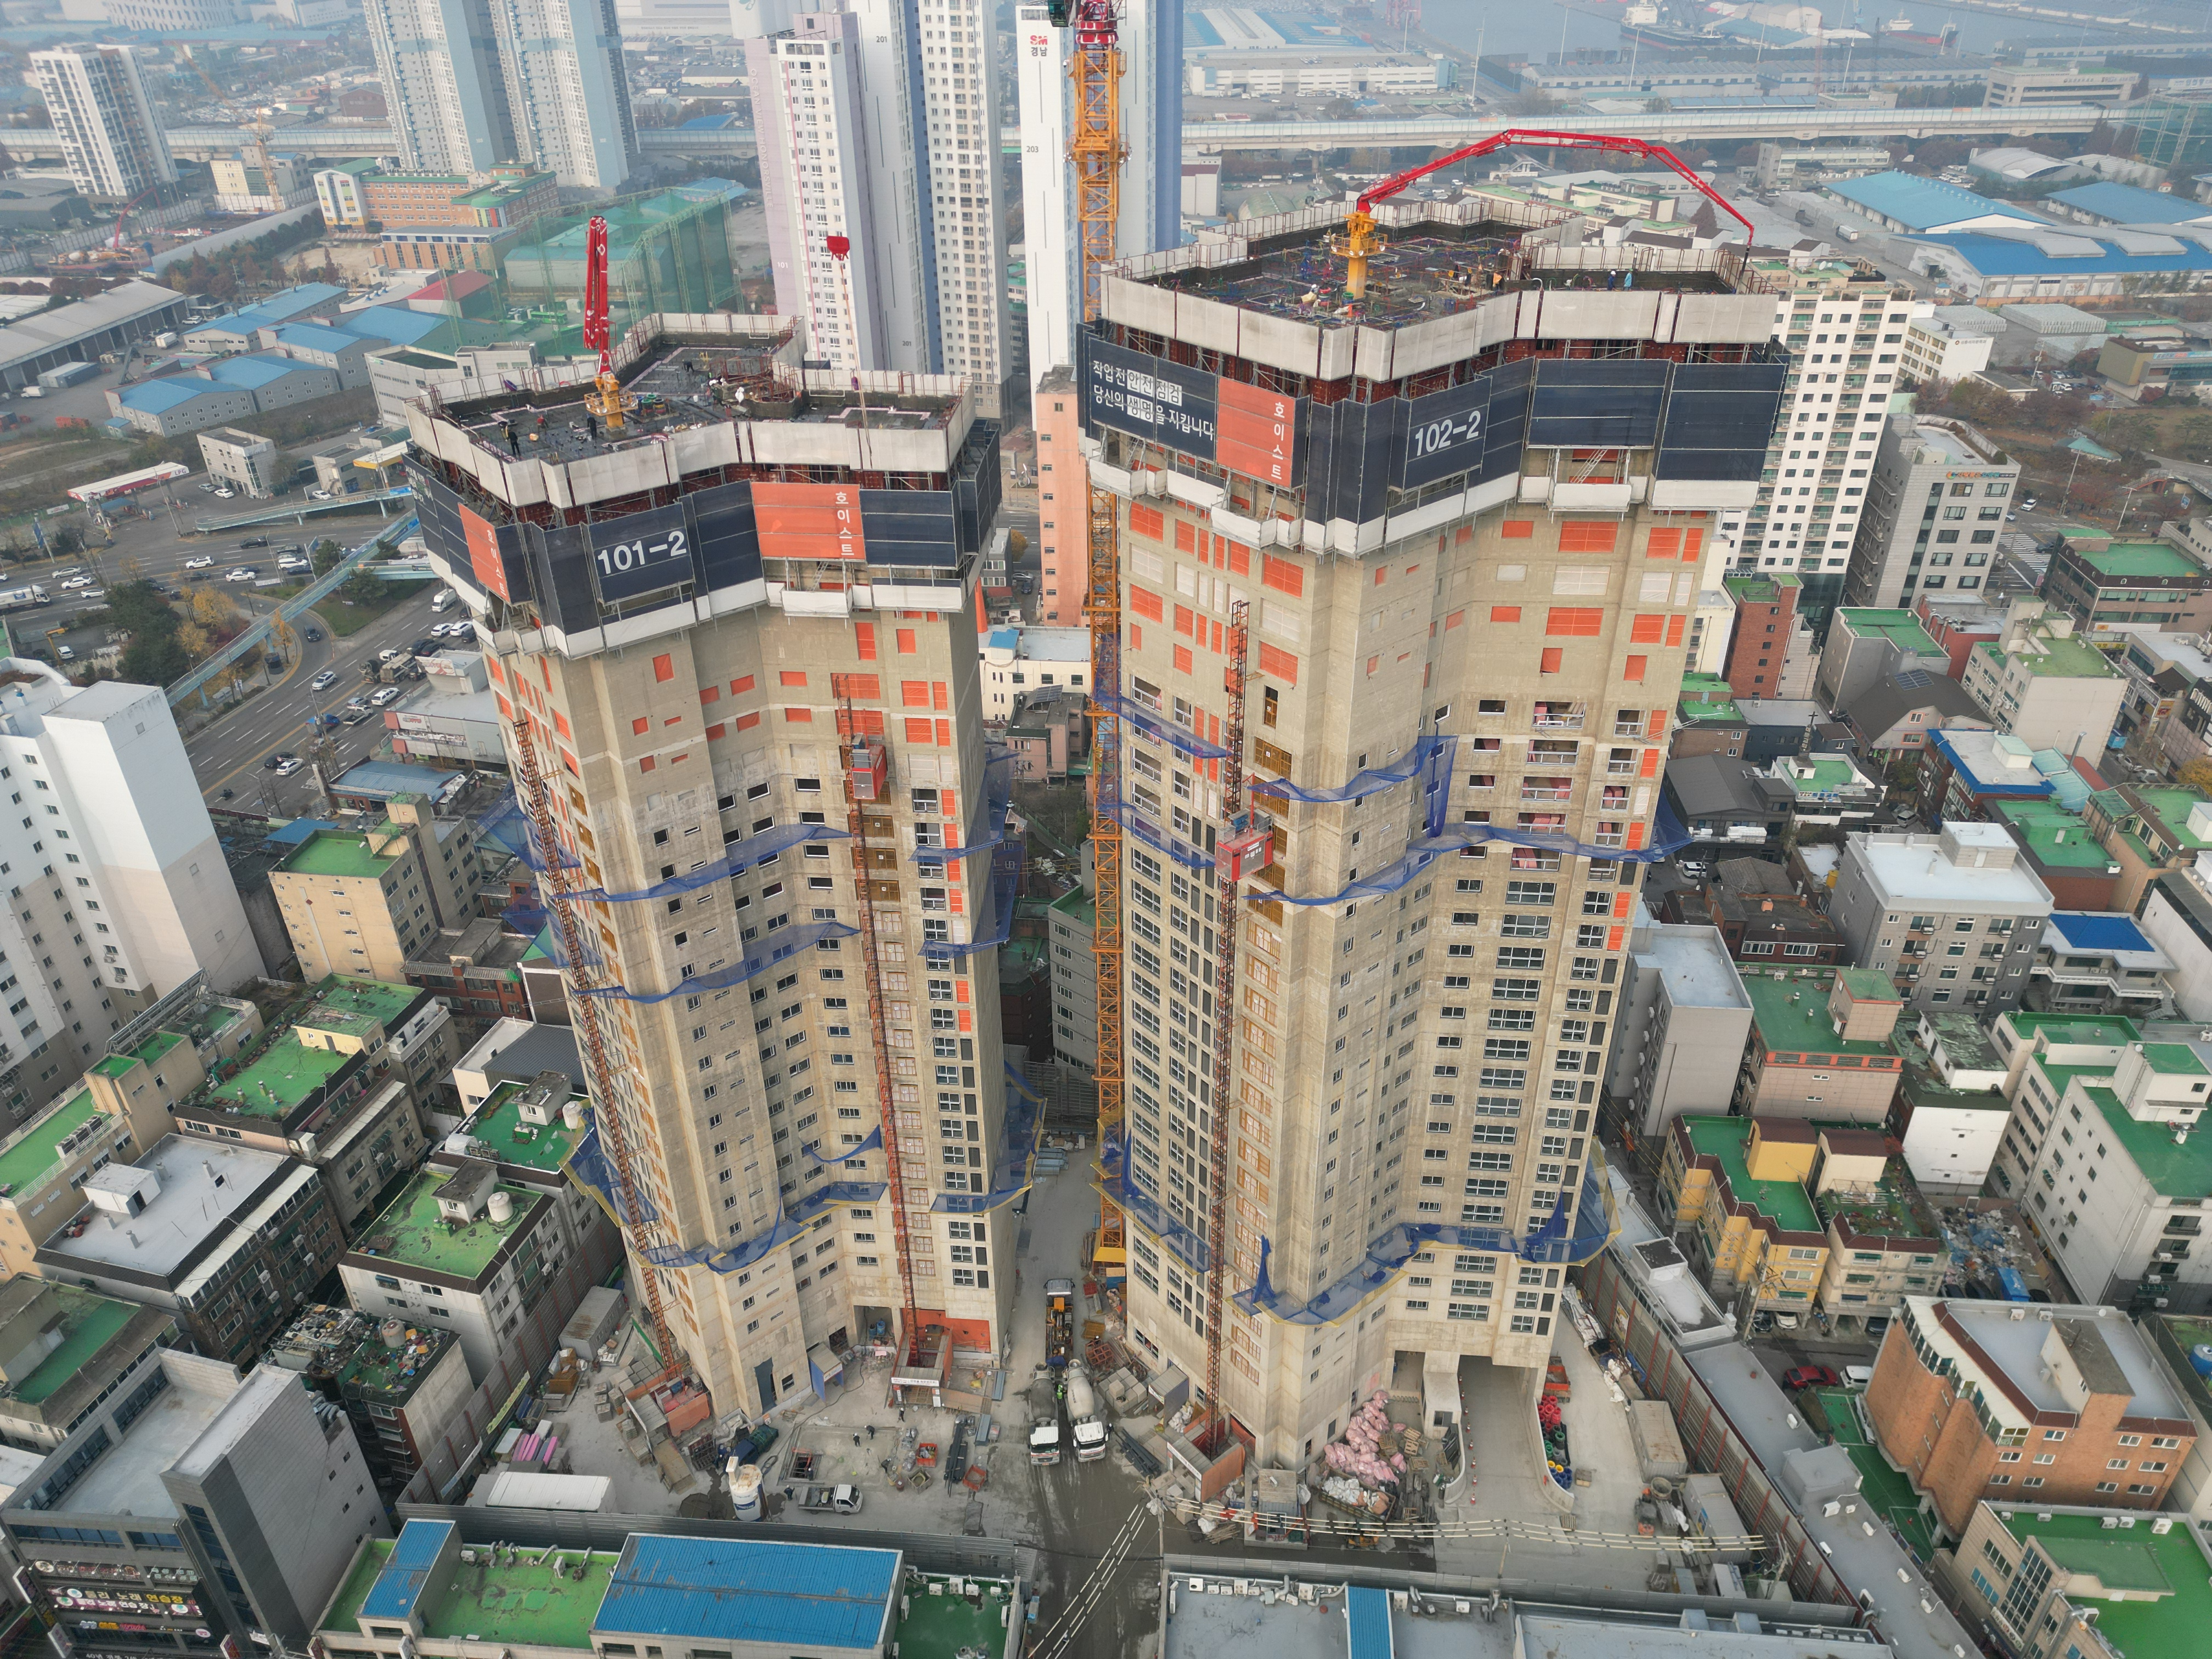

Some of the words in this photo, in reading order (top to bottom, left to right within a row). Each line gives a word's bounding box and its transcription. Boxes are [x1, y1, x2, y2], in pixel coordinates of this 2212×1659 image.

[1030, 35, 1047, 45] SM
[1031, 47, 1047, 57] 경남
[751, 69, 760, 105] OCEAN
[756, 110, 764, 133] VIEW
[759, 138, 773, 208] HONORSVILLE
[1127, 370, 1181, 404] 안전점검
[1094, 385, 1124, 411] 당신의
[1128, 397, 1165, 425] 생명을
[1169, 409, 1214, 441] 지킵니다
[1271, 402, 1285, 480] 호이스트
[1415, 410, 1481, 456] 102-2
[835, 491, 855, 556] 호이스트
[488, 529, 507, 596] 호이스트
[597, 531, 687, 574] 101-2
[116, 1592, 143, 1601] 노래
[146, 1594, 184, 1604] 연습장
[119, 1601, 149, 1609] 연습장
